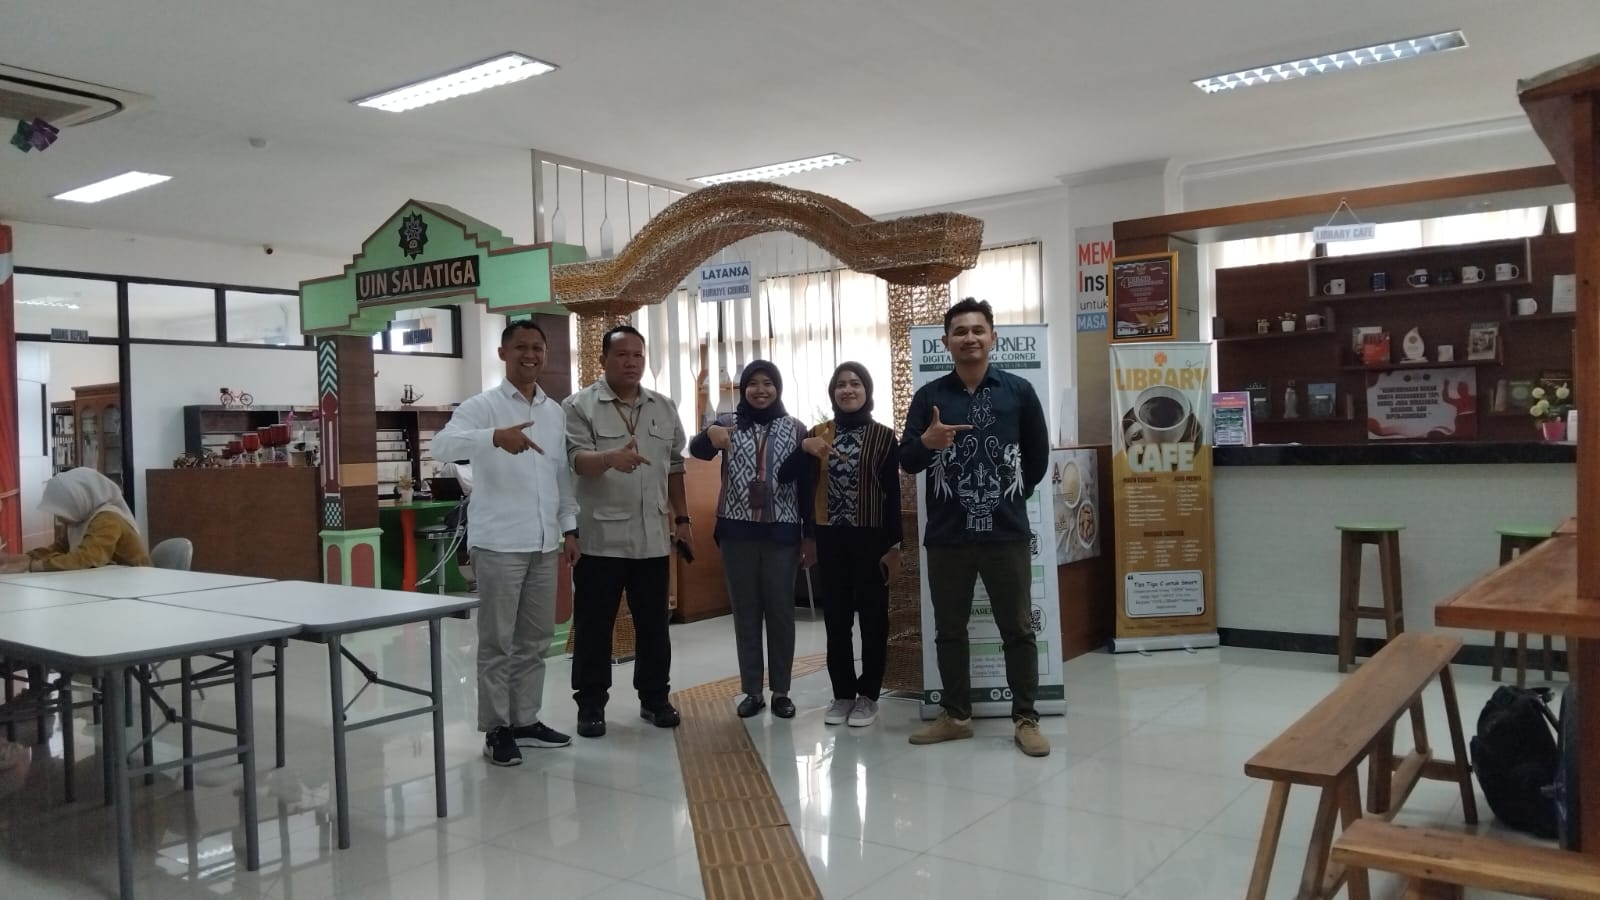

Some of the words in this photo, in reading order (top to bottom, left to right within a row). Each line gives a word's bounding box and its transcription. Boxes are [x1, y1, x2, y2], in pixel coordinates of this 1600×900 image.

[1316, 230, 1351, 240] LIBRARY
[1353, 226, 1374, 238] CAFE
[360, 272, 387, 298] UIN
[391, 259, 476, 294] SALATIGA
[702, 266, 749, 280] LATANSA
[728, 285, 749, 296] CORNER
[1078, 314, 1107, 330] MASA
[990, 336, 1036, 352] RNER
[1001, 352, 1036, 361] CORNER
[1115, 368, 1209, 391] LIBRARY
[1127, 442, 1194, 473] CAFE
